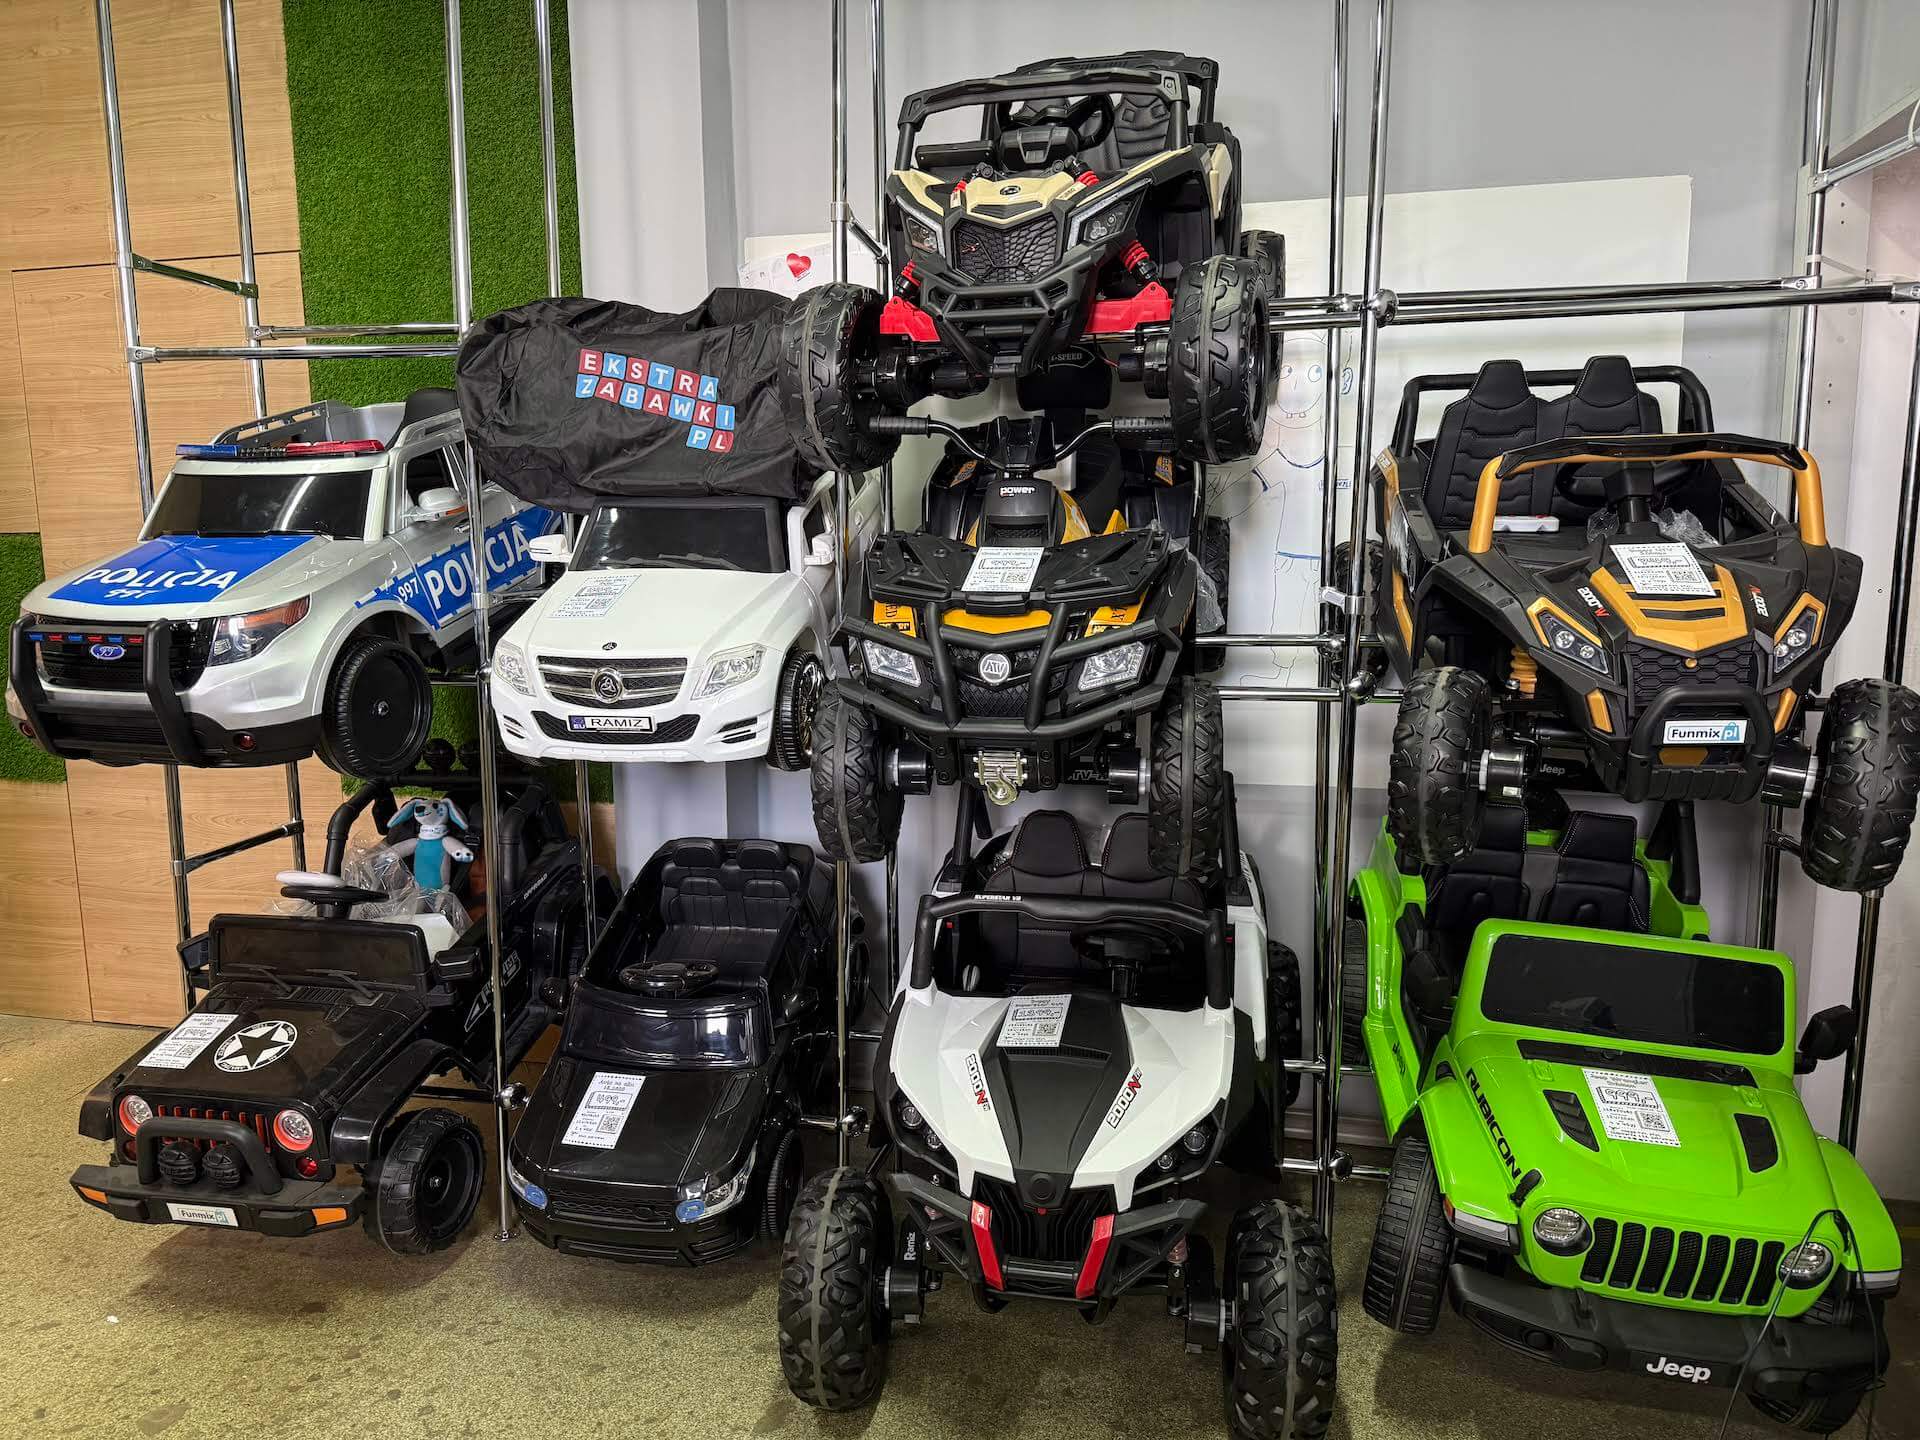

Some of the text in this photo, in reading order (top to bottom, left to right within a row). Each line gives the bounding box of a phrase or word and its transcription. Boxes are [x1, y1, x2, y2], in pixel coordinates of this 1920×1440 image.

[582, 352, 717, 400] EKSTRA
[579, 378, 732, 427] ZABAWKI
[690, 431, 730, 451] PL
[999, 486, 1036, 497] power
[72, 567, 238, 589] POLICJA
[398, 577, 420, 602] 997
[984, 660, 1009, 677] ATV
[591, 718, 643, 727] RAMIZ
[1671, 728, 1721, 739] Funmix
[1540, 763, 1566, 776] Jeep
[1465, 1067, 1522, 1180] RUBICON
[903, 1231, 916, 1261] Ramiz
[1645, 1356, 1712, 1384] Jeep
